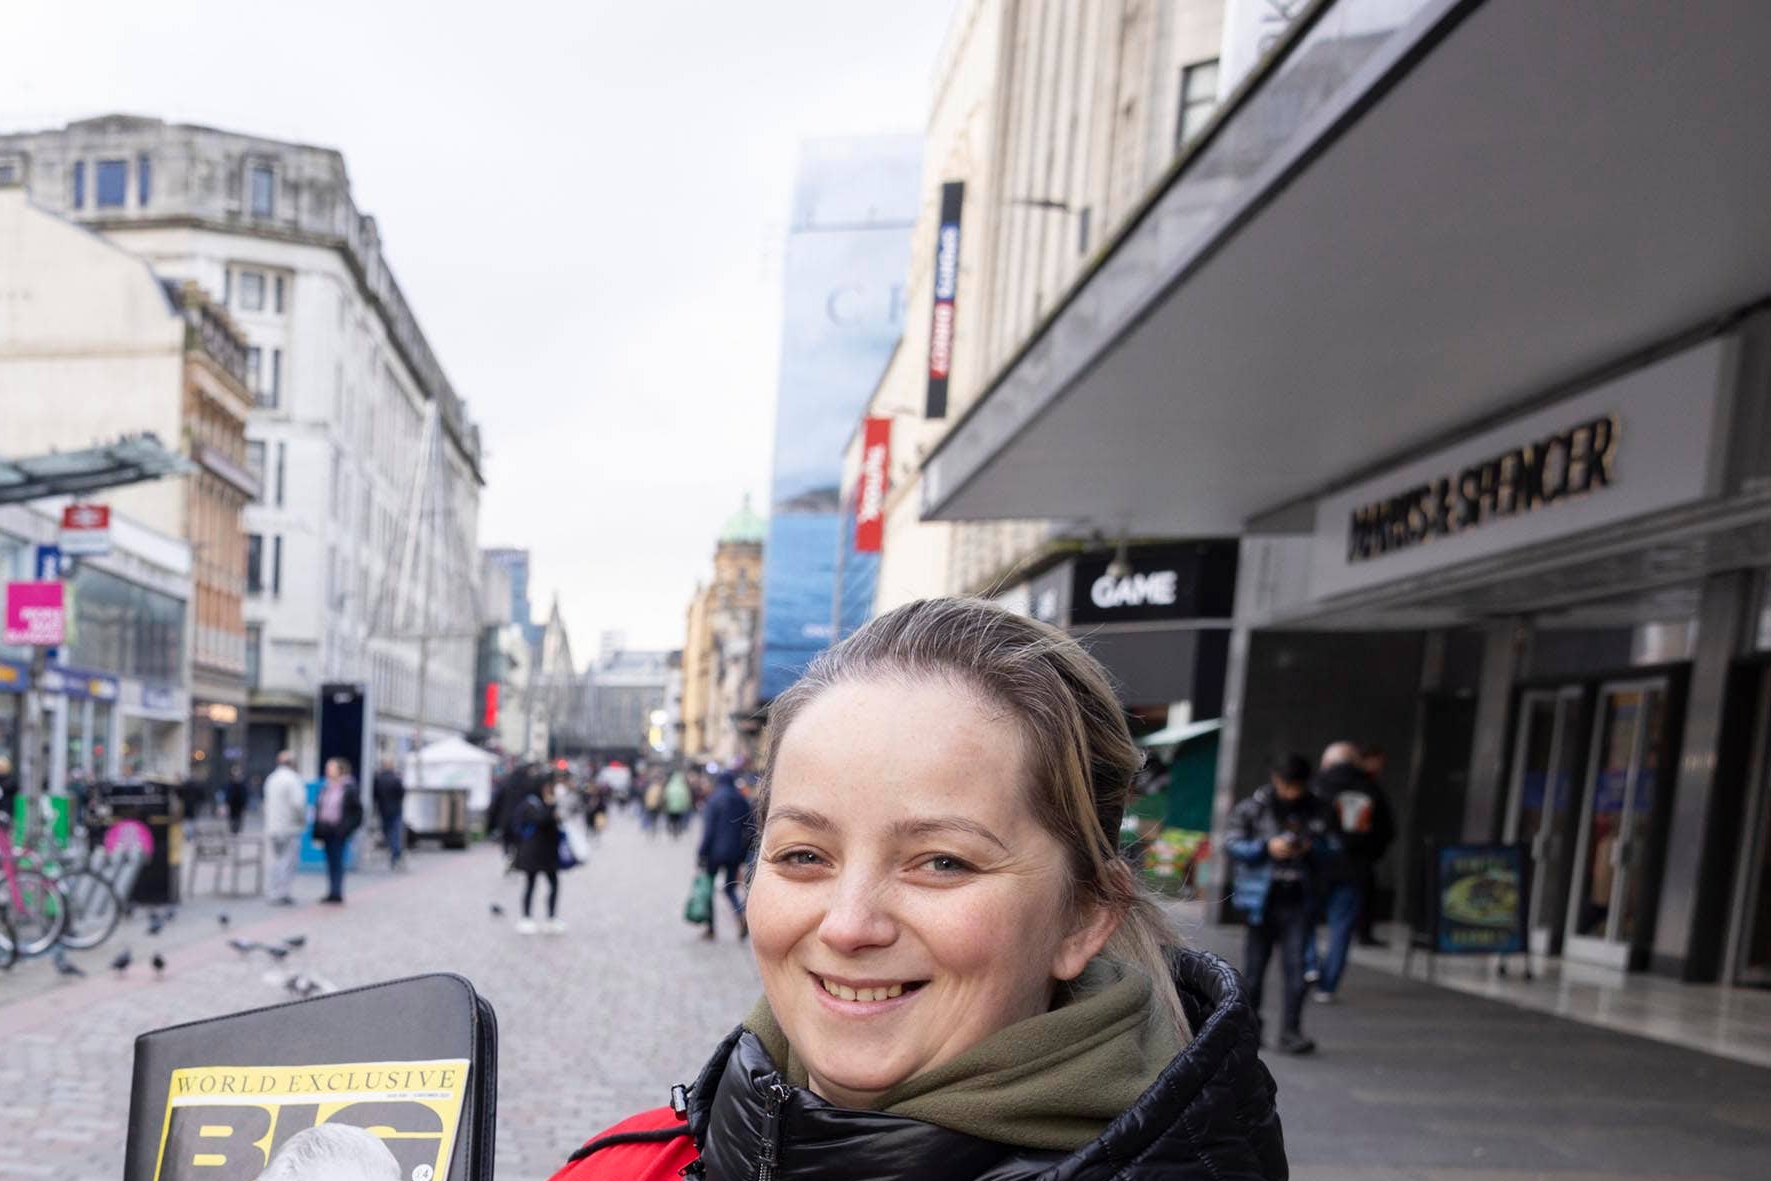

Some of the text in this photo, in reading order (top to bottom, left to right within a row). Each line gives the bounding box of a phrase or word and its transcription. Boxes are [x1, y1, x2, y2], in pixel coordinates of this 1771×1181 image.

[1091, 569, 1177, 608] GAME
[177, 1069, 456, 1094] WORLD EXCLUSIVE
